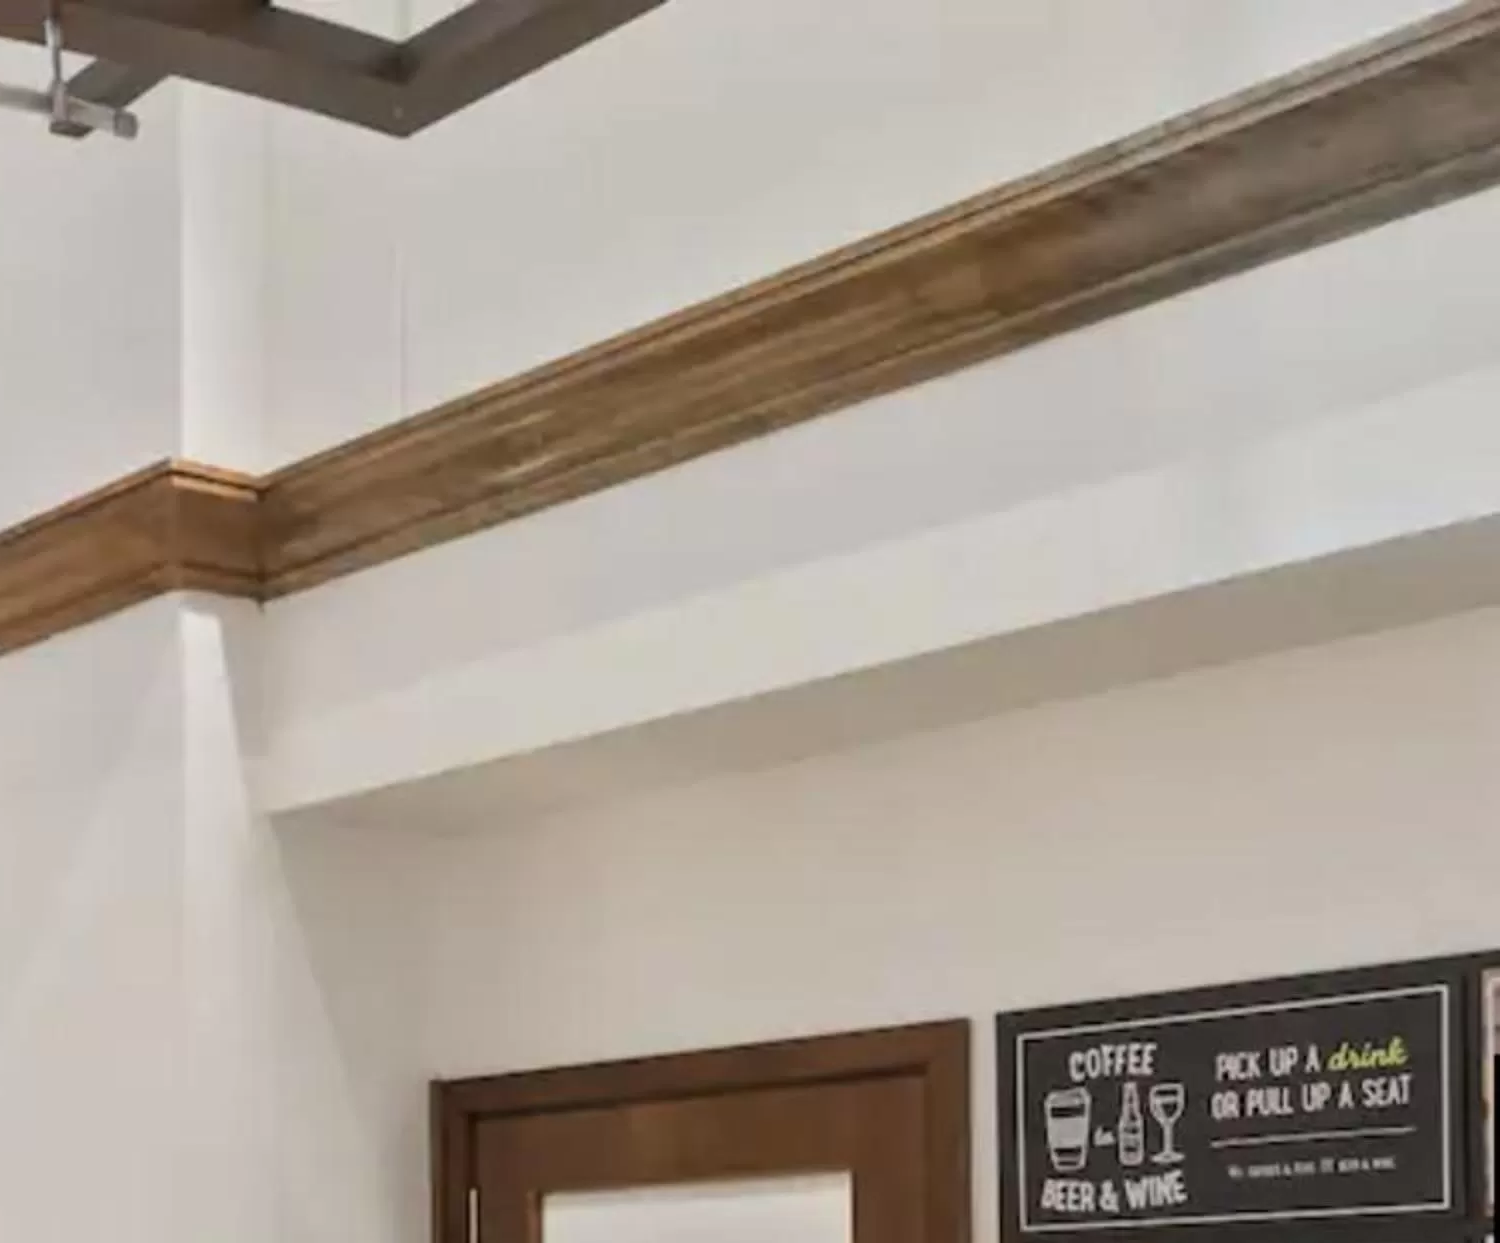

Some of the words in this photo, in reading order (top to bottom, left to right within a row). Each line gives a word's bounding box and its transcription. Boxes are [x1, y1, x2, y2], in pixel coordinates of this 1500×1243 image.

[1069, 1042, 1157, 1082] COFFEE
[1215, 1051, 1260, 1081] PICK
[1269, 1046, 1298, 1076] UP
[1304, 1043, 1320, 1073] A
[1327, 1035, 1408, 1071] drink
[1211, 1090, 1240, 1120] OR
[1246, 1086, 1294, 1117] PULL
[1302, 1081, 1331, 1112] UP
[1338, 1080, 1354, 1109] A
[1361, 1073, 1411, 1108] SEAT
[1041, 1179, 1095, 1212] BEER
[1099, 1179, 1119, 1212] &
[1124, 1169, 1187, 1209] WINE
